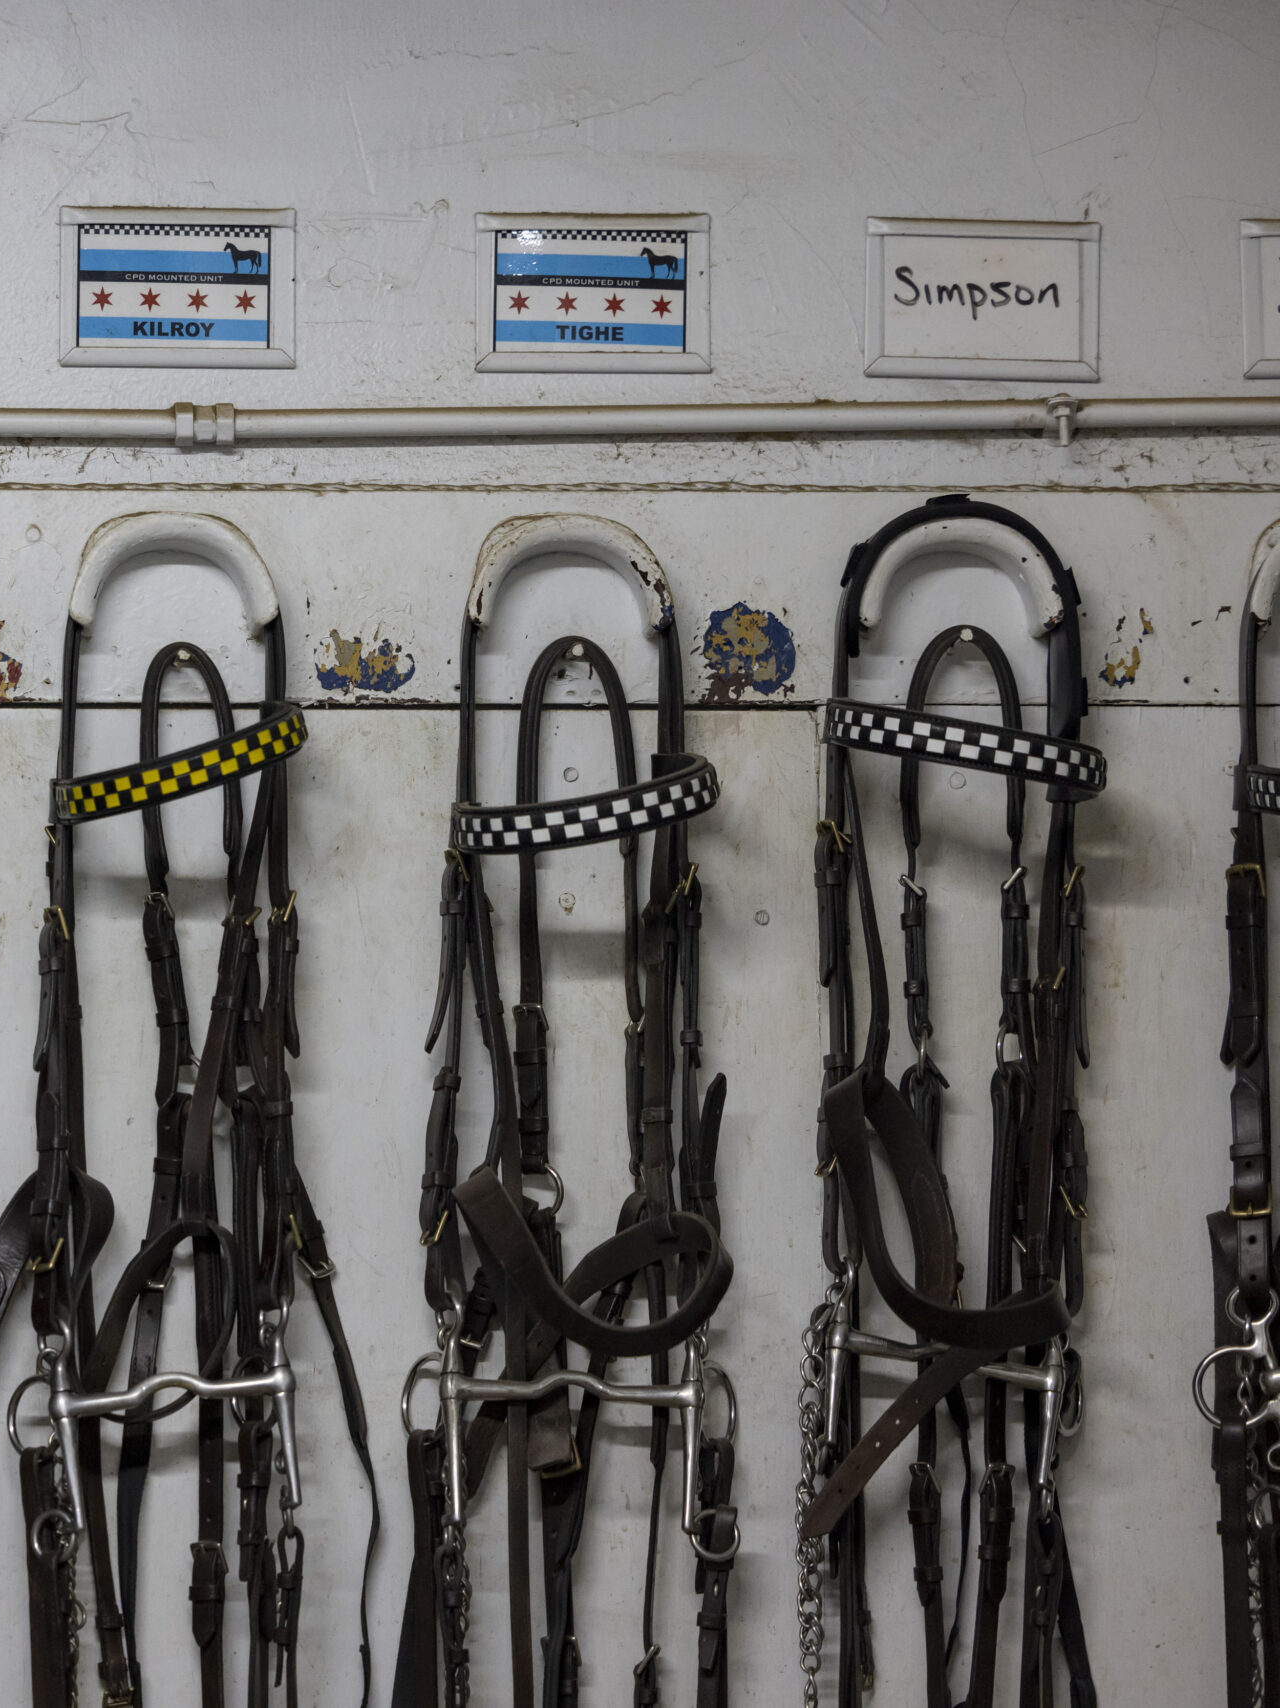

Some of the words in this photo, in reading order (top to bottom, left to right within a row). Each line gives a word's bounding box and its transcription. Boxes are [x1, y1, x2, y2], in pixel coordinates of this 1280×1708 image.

[125, 273, 145, 281] CPD
[148, 273, 197, 282] MOUNTED
[542, 277, 562, 285] CPD
[565, 278, 614, 286] MOUNTED
[617, 279, 641, 287] UNIT
[894, 265, 1060, 321] Simpson
[133, 321, 215, 338] KILROY
[556, 325, 624, 341] TIGHE
